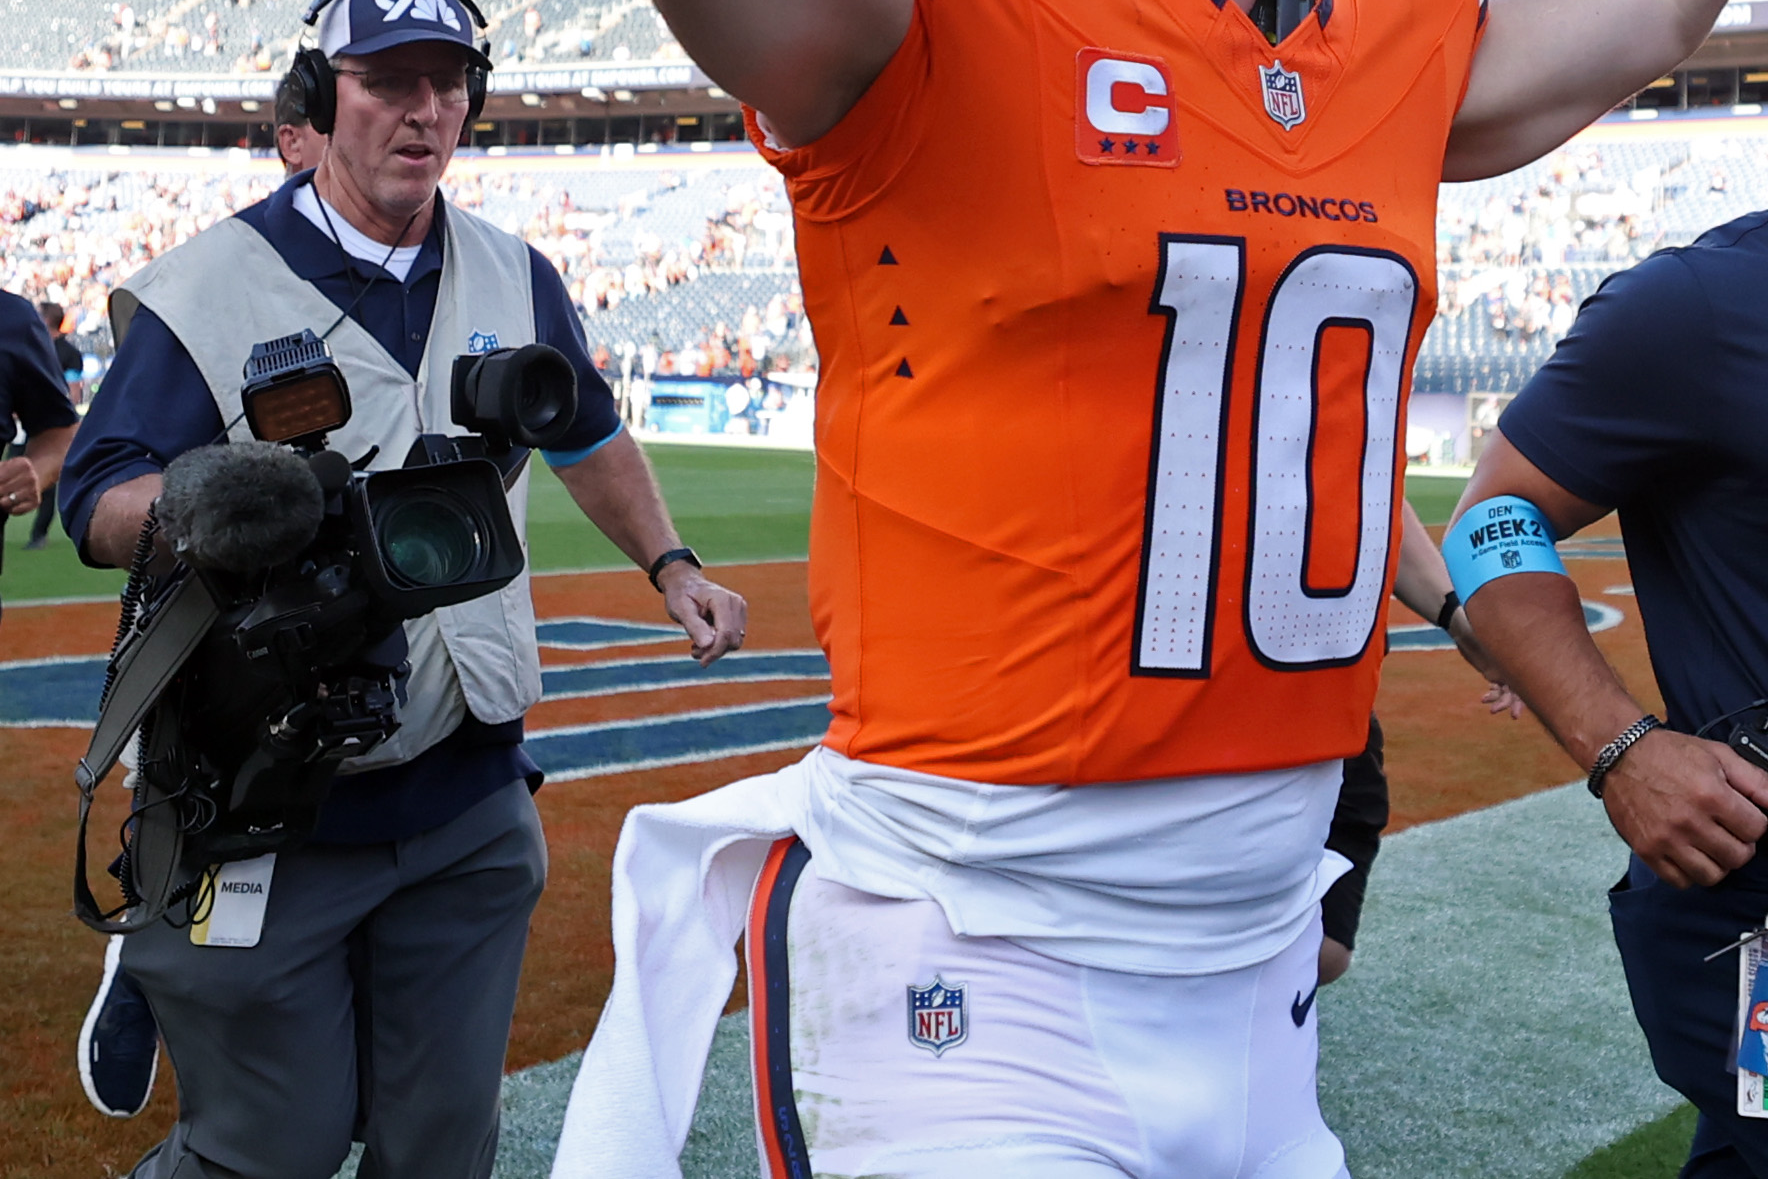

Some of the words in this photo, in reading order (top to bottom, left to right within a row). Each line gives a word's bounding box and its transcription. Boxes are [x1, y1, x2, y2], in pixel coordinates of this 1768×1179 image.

[1086, 58, 1171, 137] C
[1270, 90, 1299, 121] NFL
[1225, 188, 1379, 223] BRONCOS
[1130, 231, 1420, 679] 10
[1488, 505, 1513, 519] DEN
[1469, 518, 1529, 549] WEEK
[1530, 521, 1543, 538] 2
[1499, 539, 1519, 549] Field
[220, 881, 263, 895] MEDIA
[916, 1009, 959, 1041] NFL
